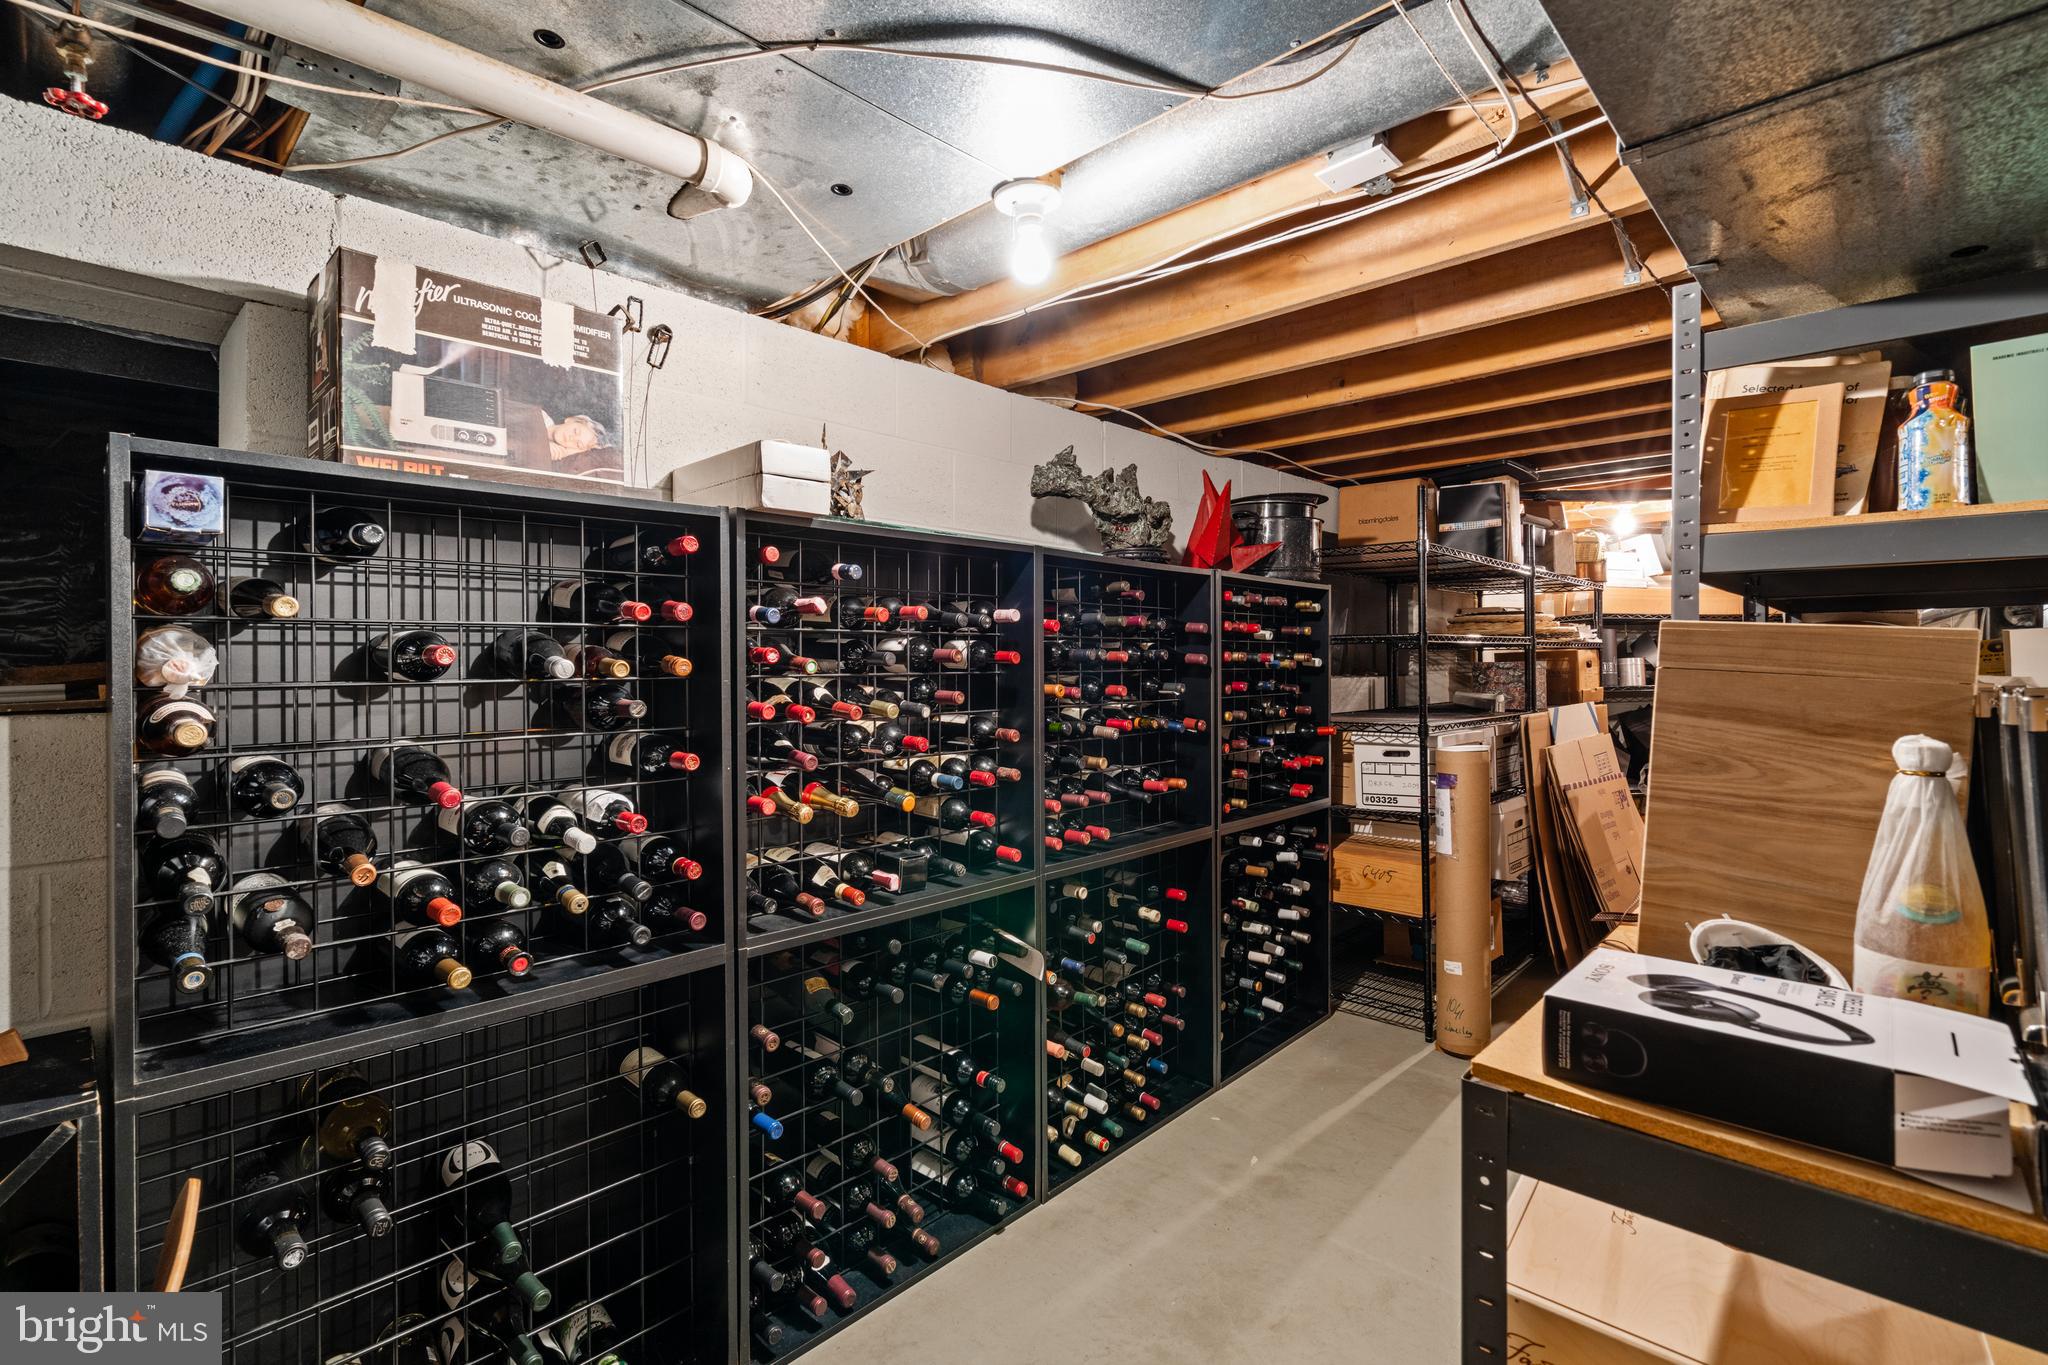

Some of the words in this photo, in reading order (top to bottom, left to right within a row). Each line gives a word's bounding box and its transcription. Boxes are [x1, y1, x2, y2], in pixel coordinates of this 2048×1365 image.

[453, 294, 513, 317] ULTRASONIC
[574, 323, 611, 340] MIDIFIER
[1742, 383, 1795, 394] Selected
[1846, 382, 1860, 392] of
[1364, 796, 1399, 805] #03325
[1585, 963, 1615, 983] SONY
